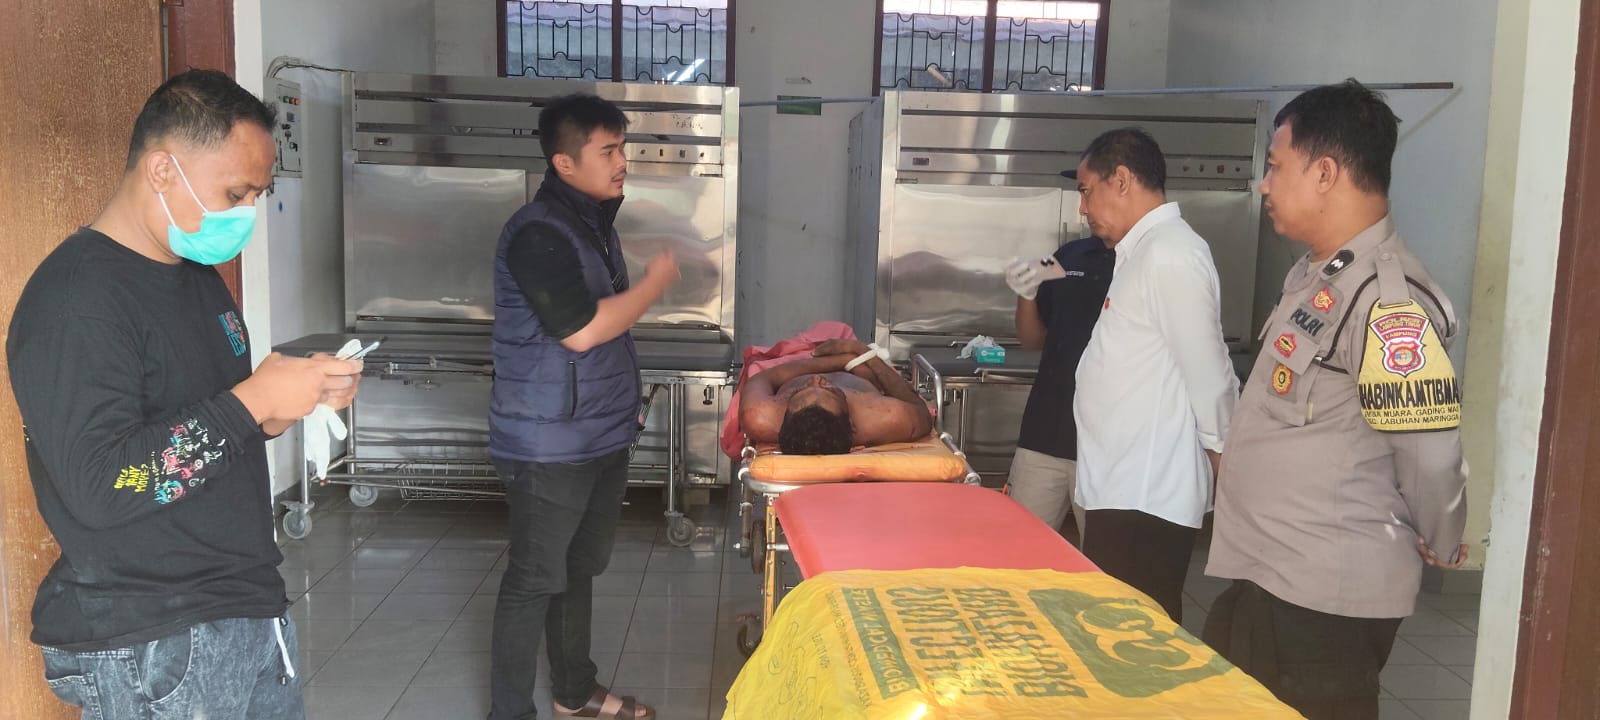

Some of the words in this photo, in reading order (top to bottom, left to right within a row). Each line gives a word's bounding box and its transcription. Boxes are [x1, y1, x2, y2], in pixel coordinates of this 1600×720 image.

[1290, 308, 1324, 337] POLRI
[1359, 377, 1460, 410] HABINKAMTIBMA
[1380, 415, 1420, 425] LABUHAN
[1383, 409, 1413, 418] MUARA
[1415, 406, 1446, 416] GADING
